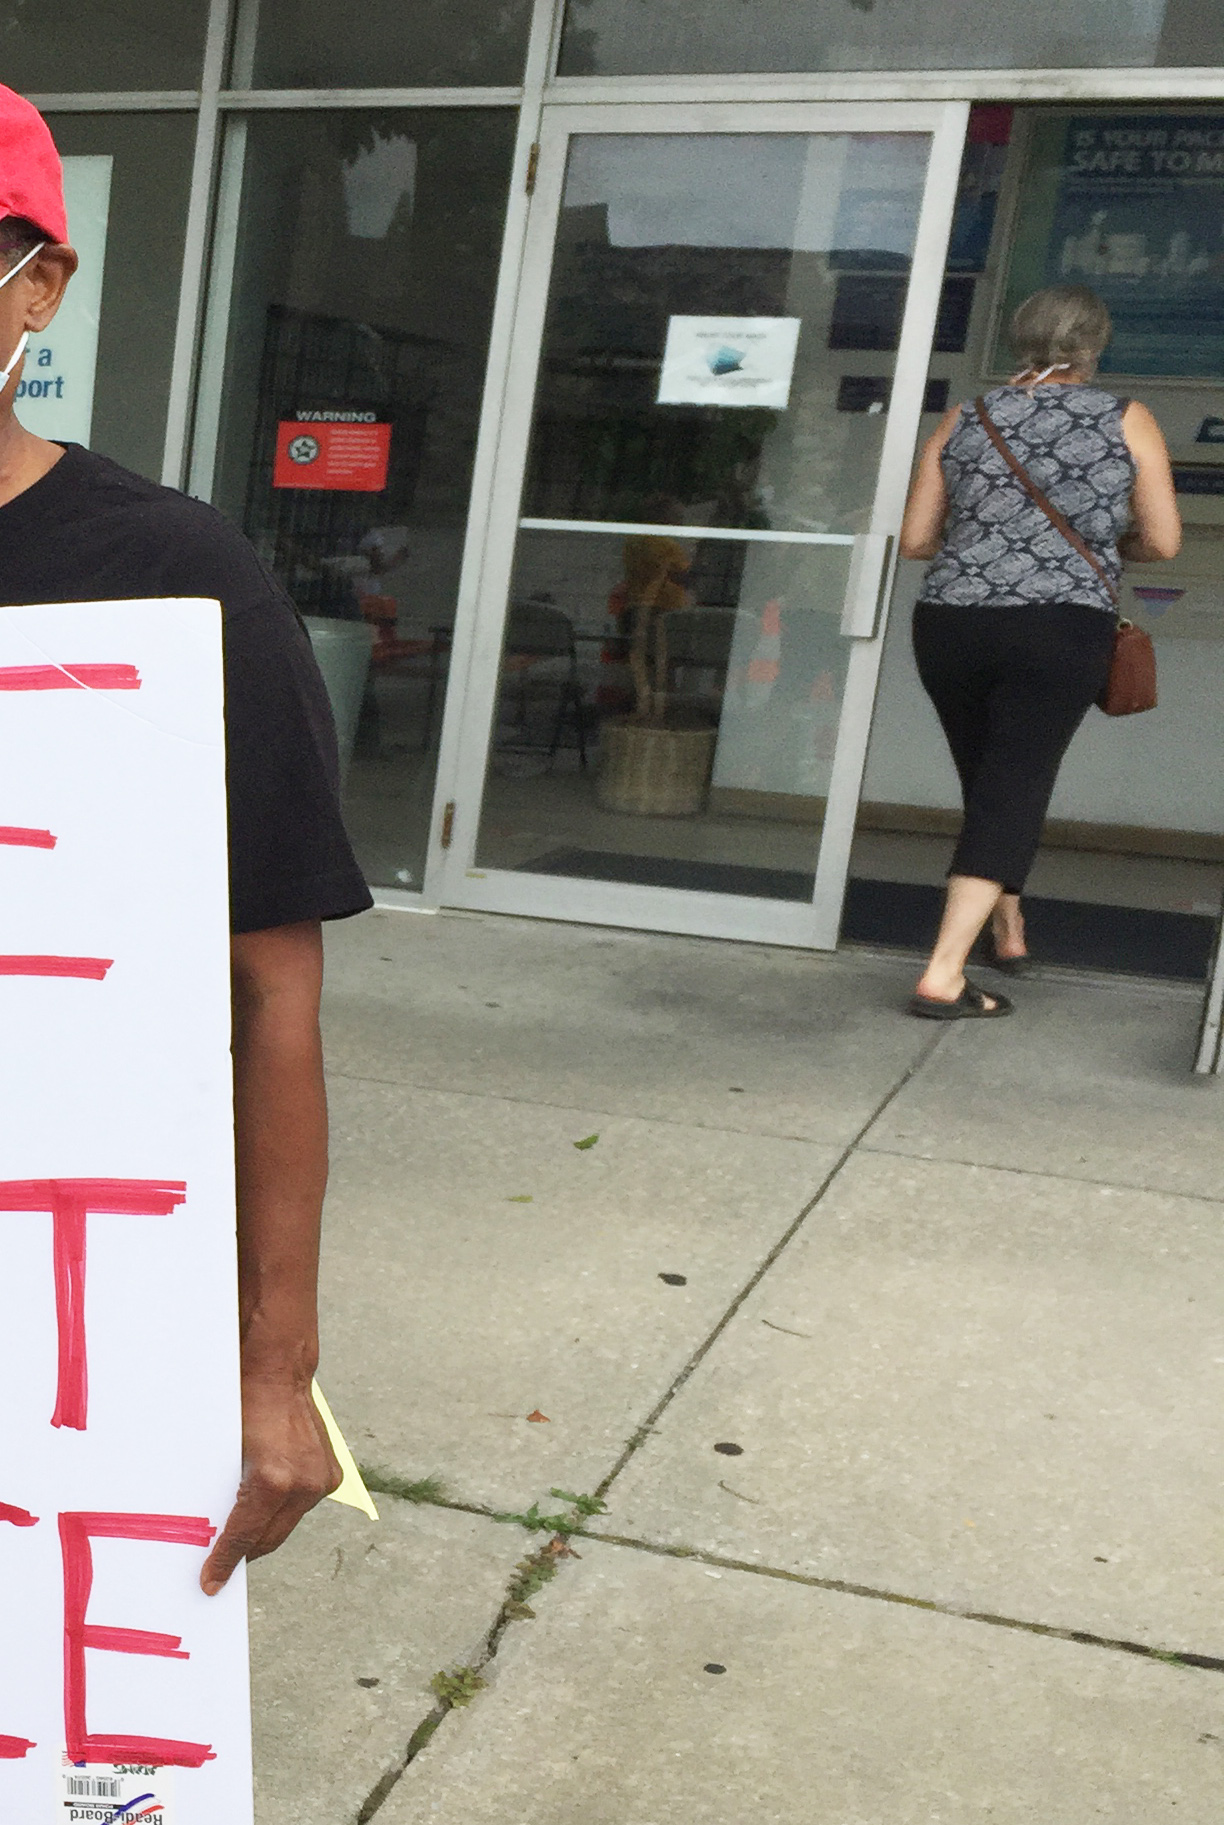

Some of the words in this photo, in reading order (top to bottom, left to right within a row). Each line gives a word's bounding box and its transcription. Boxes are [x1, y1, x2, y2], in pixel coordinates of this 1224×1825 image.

[1073, 151, 1142, 172] SAFE
[1150, 151, 1191, 172] TO
[38, 348, 52, 367] a
[296, 410, 376, 423] WARNING
